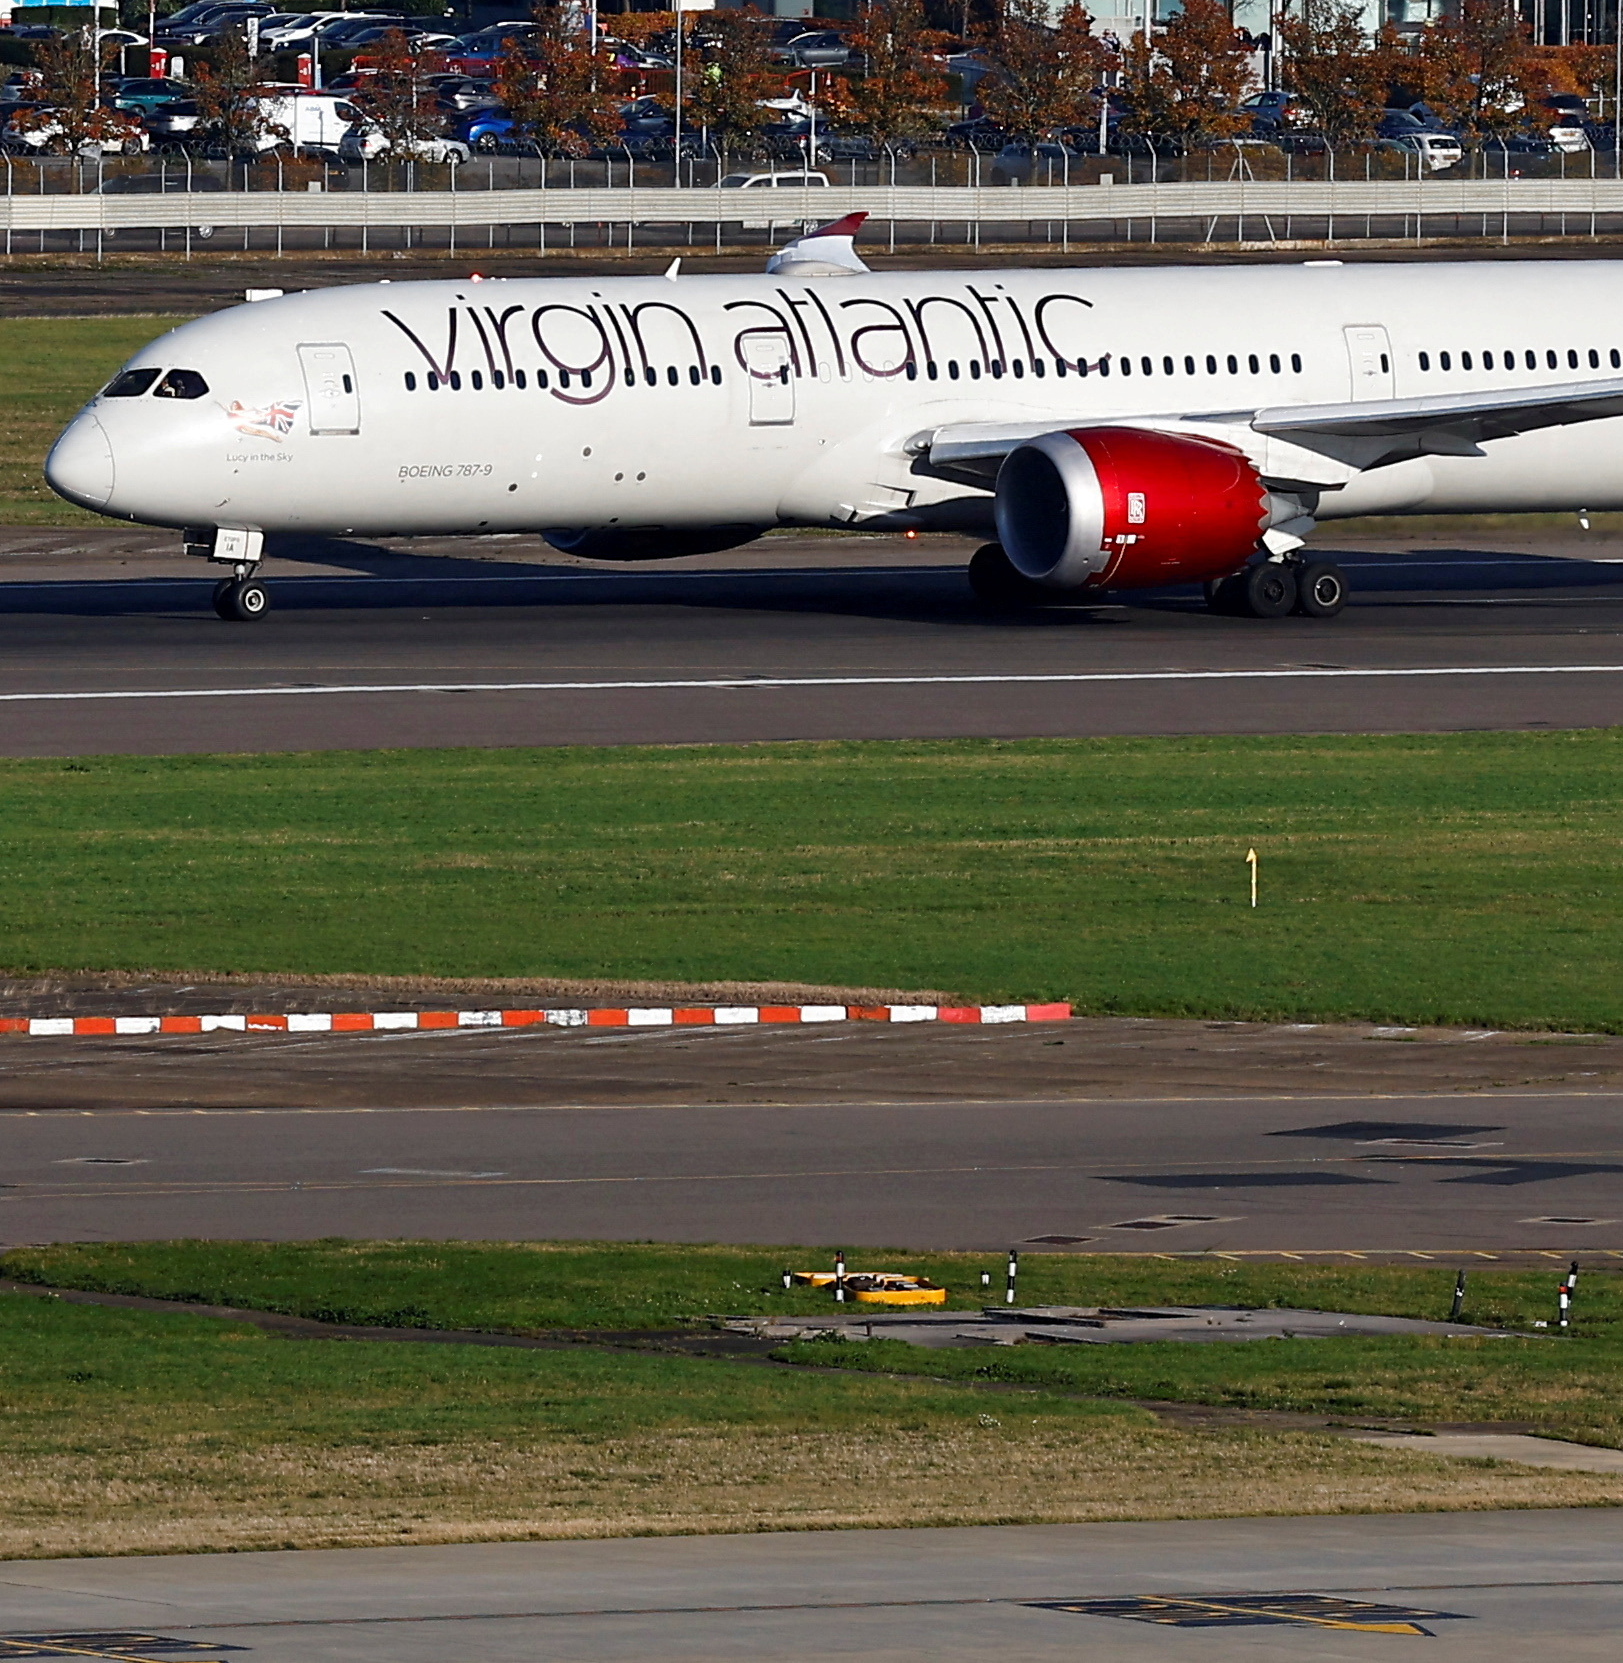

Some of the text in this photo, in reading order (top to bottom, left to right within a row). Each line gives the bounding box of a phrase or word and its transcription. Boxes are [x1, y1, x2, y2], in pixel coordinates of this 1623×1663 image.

[380, 284, 1113, 405] virgin atlantic
[226, 452, 294, 463] Lucy in the Sky
[398, 464, 493, 478] BOEING 787-9
